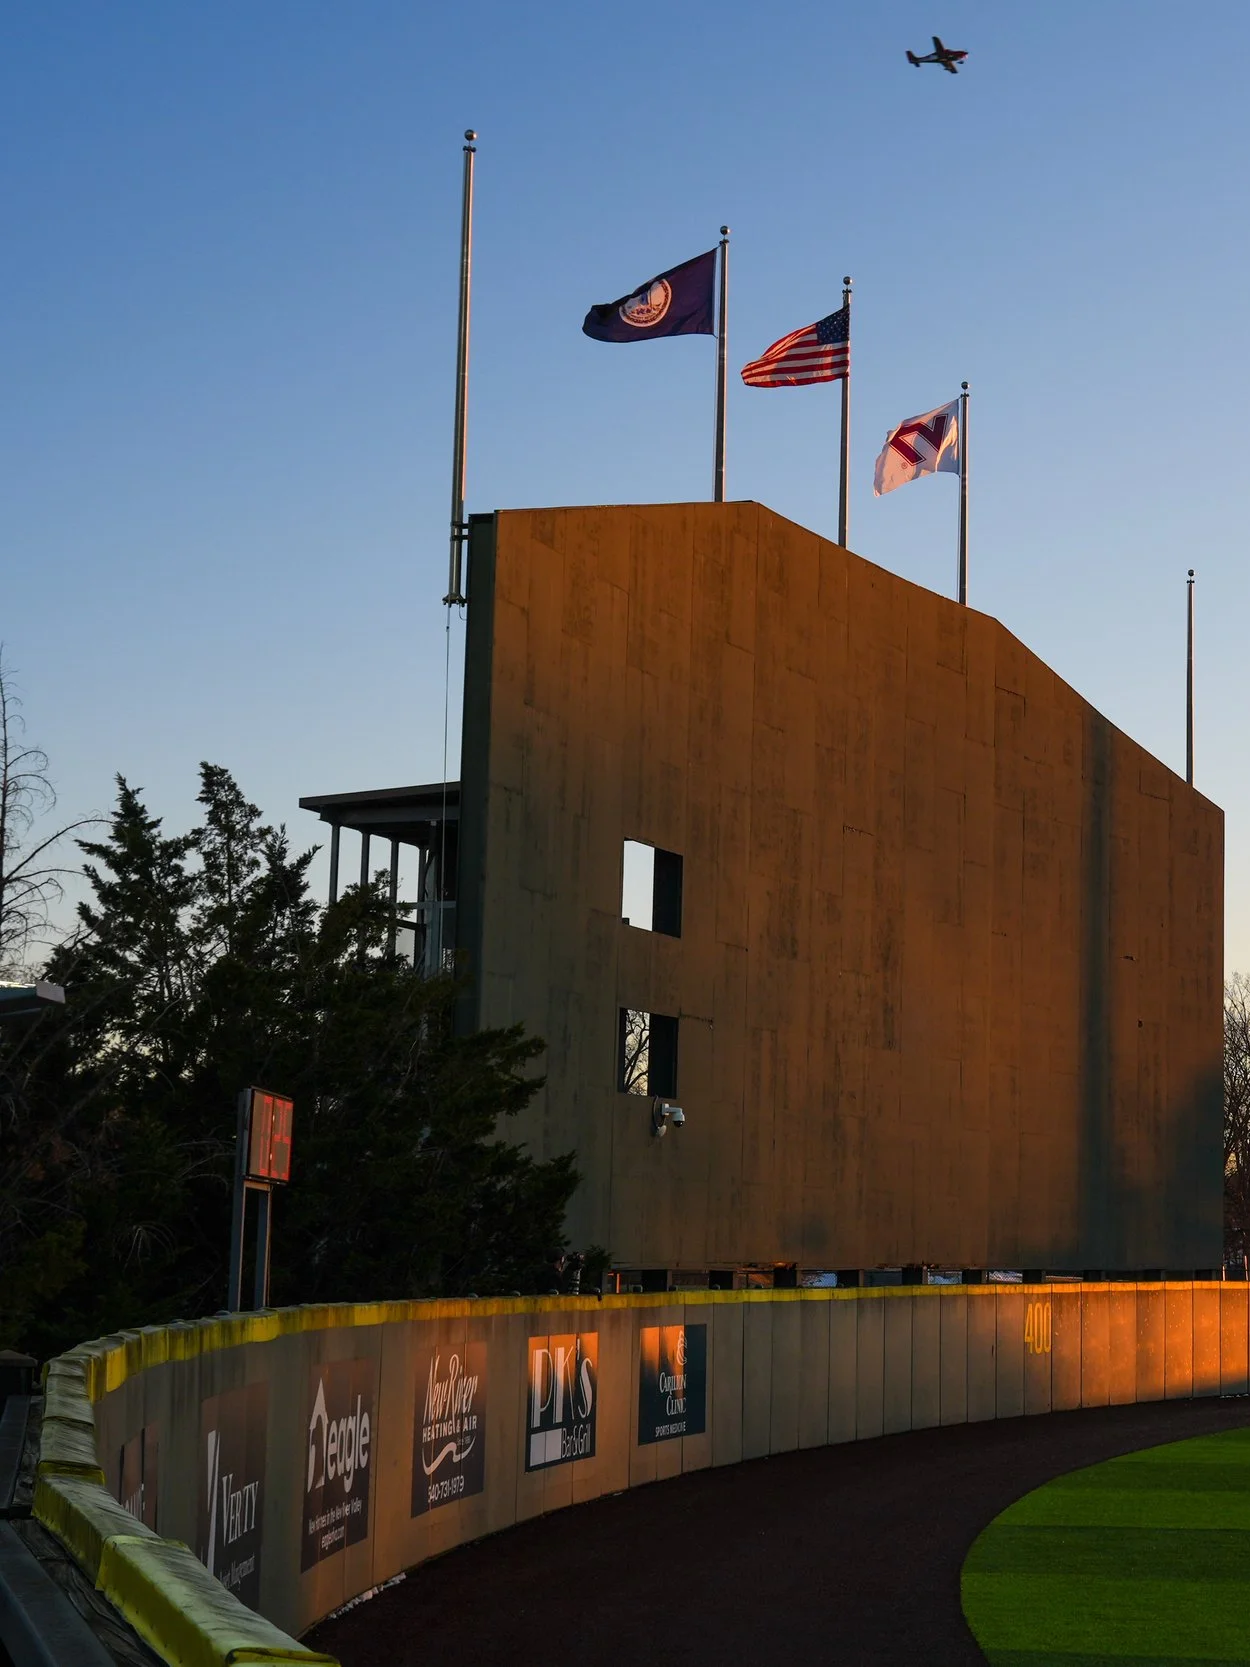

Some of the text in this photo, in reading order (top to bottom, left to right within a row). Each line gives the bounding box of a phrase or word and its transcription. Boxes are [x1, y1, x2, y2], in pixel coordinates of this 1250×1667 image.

[1025, 1302, 1051, 1354] 400
[666, 1395, 687, 1416] CLINIC
[422, 1421, 454, 1443] HEATING
[462, 1415, 477, 1432] AIR
[655, 1424, 669, 1438] SPORTS
[327, 1394, 370, 1493] eagle
